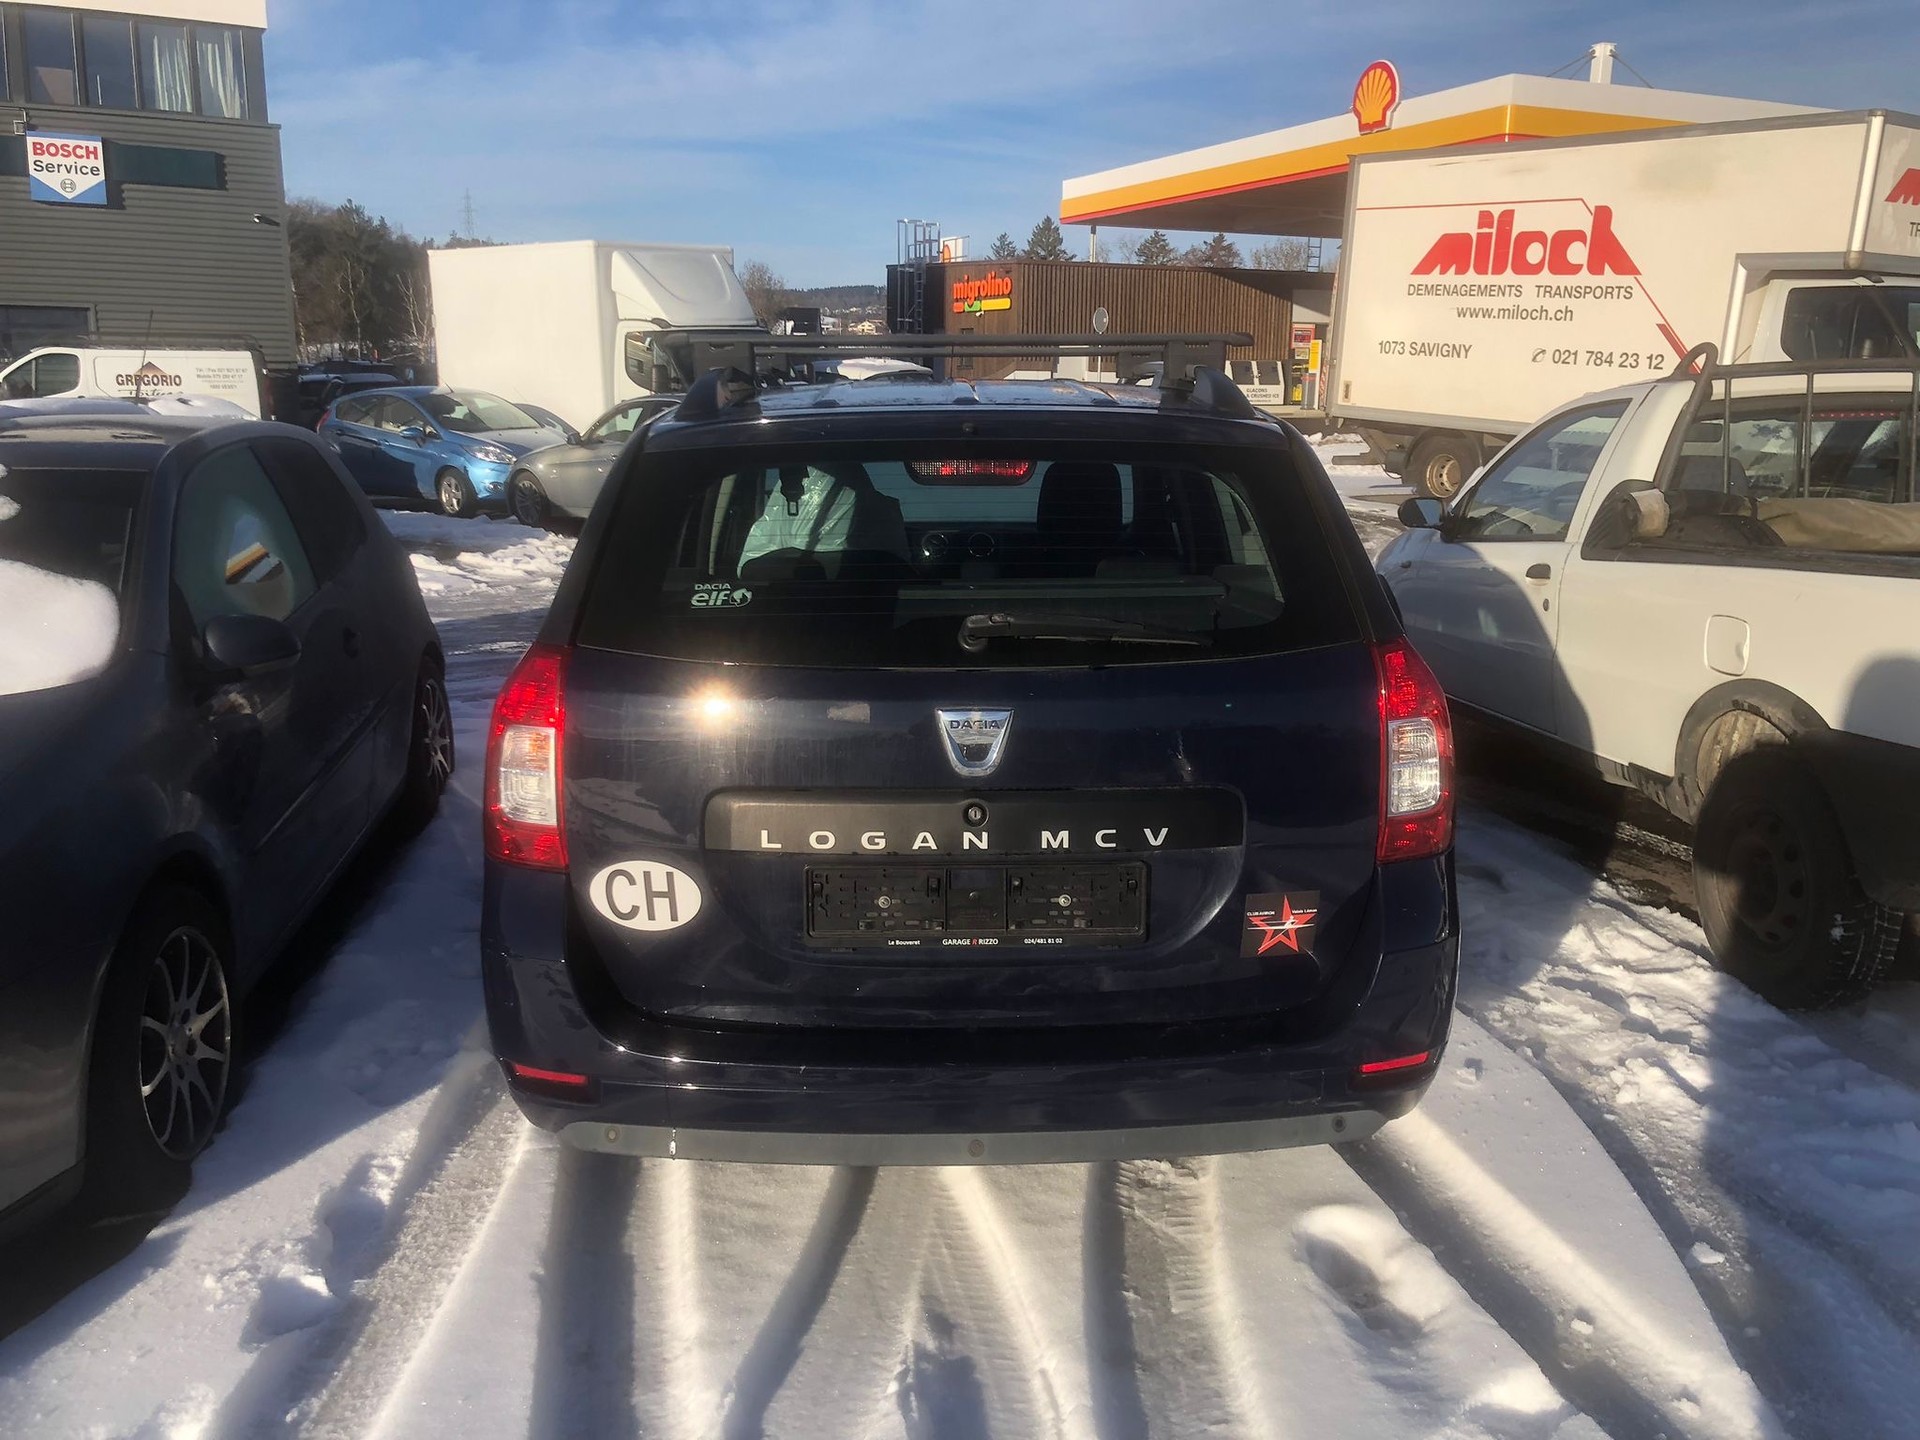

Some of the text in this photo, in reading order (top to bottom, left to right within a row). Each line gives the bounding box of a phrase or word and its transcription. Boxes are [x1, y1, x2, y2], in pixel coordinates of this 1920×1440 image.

[32, 141, 99, 160] BOSCH
[33, 159, 101, 177] Service
[1410, 205, 1642, 275] miloch
[953, 271, 1012, 306] migrolino
[1407, 283, 1634, 300] DEMENAGEMENTS TRANSPORTS
[1456, 304, 1574, 322] www.miloch.ch
[1378, 339, 1473, 360] 1073 SAVIGNY
[1552, 348, 1665, 371] 021 784 23 12
[691, 591, 731, 606] elf
[950, 720, 1000, 729] DACIA
[761, 827, 1169, 850] LOGAN MCV
[605, 869, 679, 922] CH
[942, 938, 971, 946] GARAGE
[978, 938, 999, 946] RIZZO
[1024, 937, 1047, 945] 024/481
